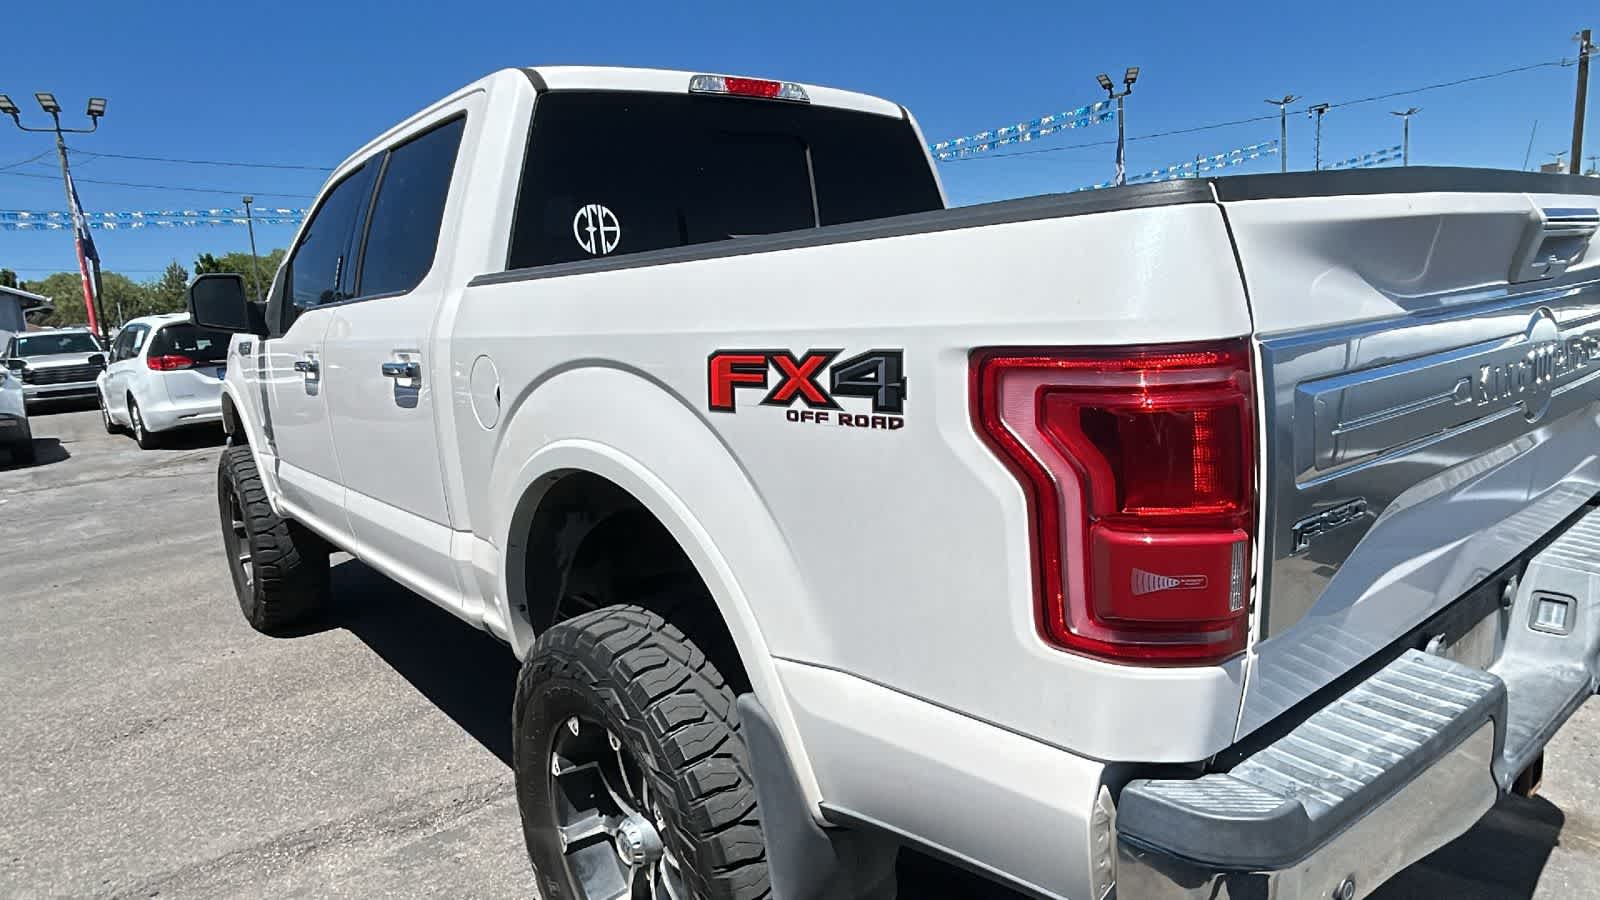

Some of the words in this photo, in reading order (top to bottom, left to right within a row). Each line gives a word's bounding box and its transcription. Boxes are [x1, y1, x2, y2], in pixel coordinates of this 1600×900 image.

[708, 348, 907, 414] FX4
[786, 409, 829, 424] OFF
[838, 412, 904, 430] ROAD
